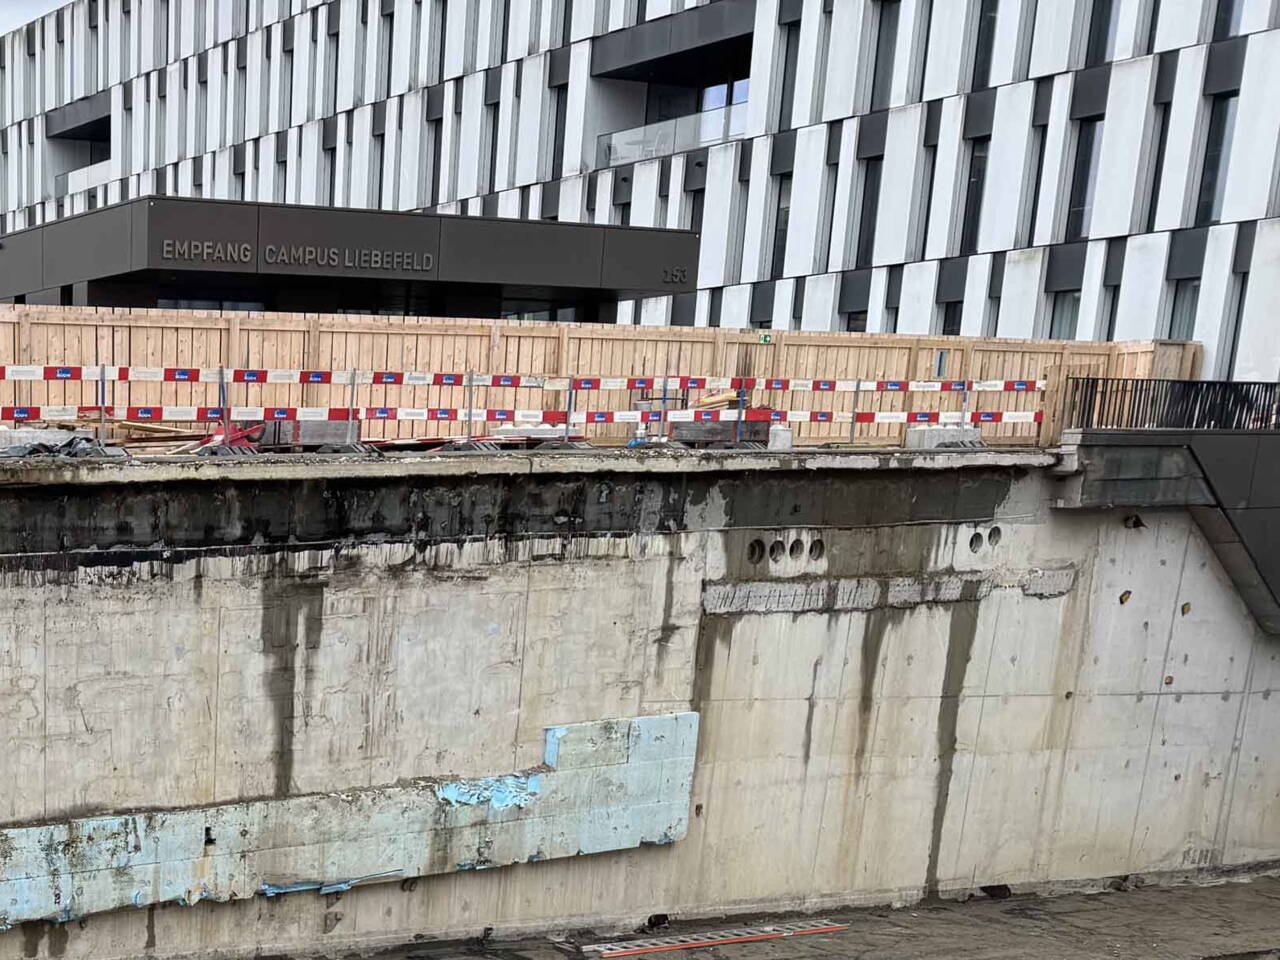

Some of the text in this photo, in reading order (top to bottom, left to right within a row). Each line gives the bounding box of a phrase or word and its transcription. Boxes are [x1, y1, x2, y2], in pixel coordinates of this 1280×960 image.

[162, 239, 433, 272] EMPFANG CAMPUS LIEBEFELD
